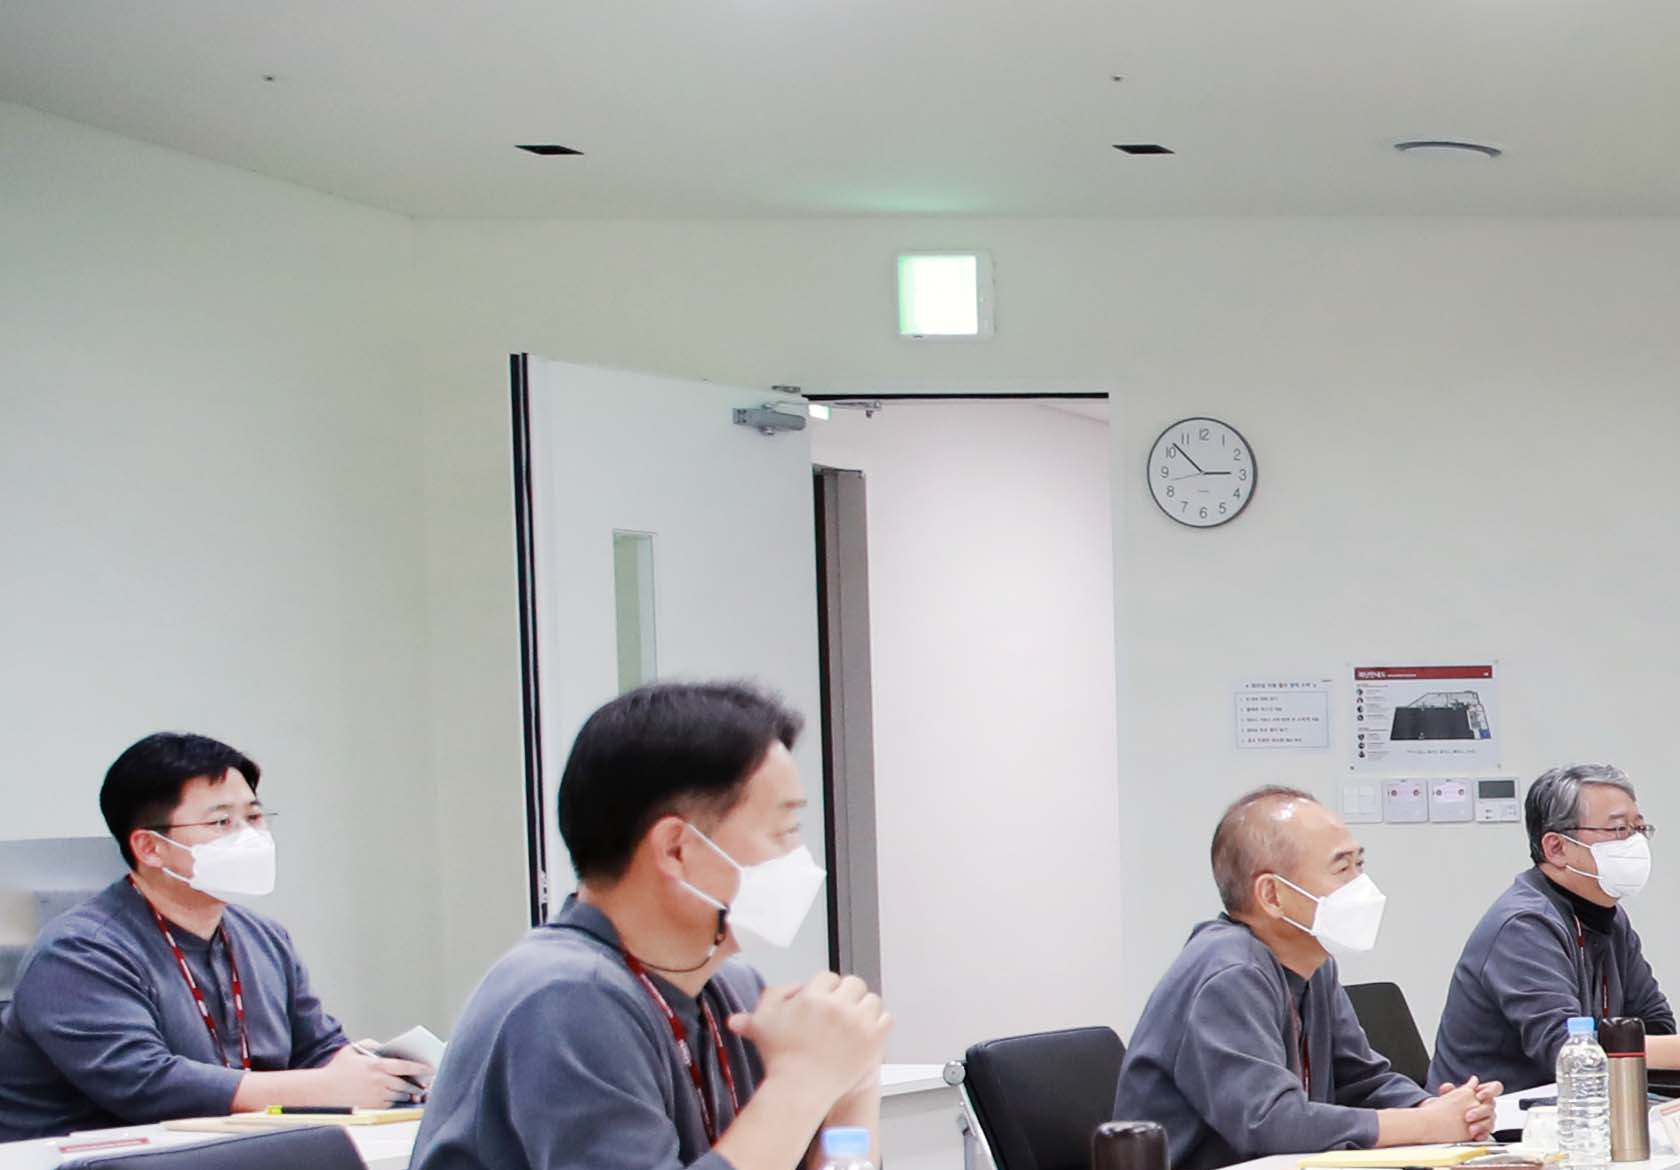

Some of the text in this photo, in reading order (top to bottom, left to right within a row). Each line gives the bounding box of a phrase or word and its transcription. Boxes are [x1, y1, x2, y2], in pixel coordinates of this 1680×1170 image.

[1181, 433, 1190, 446] 11
[1199, 428, 1210, 441] 12
[1165, 446, 1177, 459] 10
[1233, 448, 1242, 461] 2
[1160, 466, 1169, 479] 9
[1238, 468, 1248, 481] 3
[1166, 485, 1175, 498] 8
[1232, 488, 1241, 500] 4
[1180, 501, 1189, 513] 7
[1199, 506, 1208, 519] 6
[1218, 502, 1227, 514] 5
